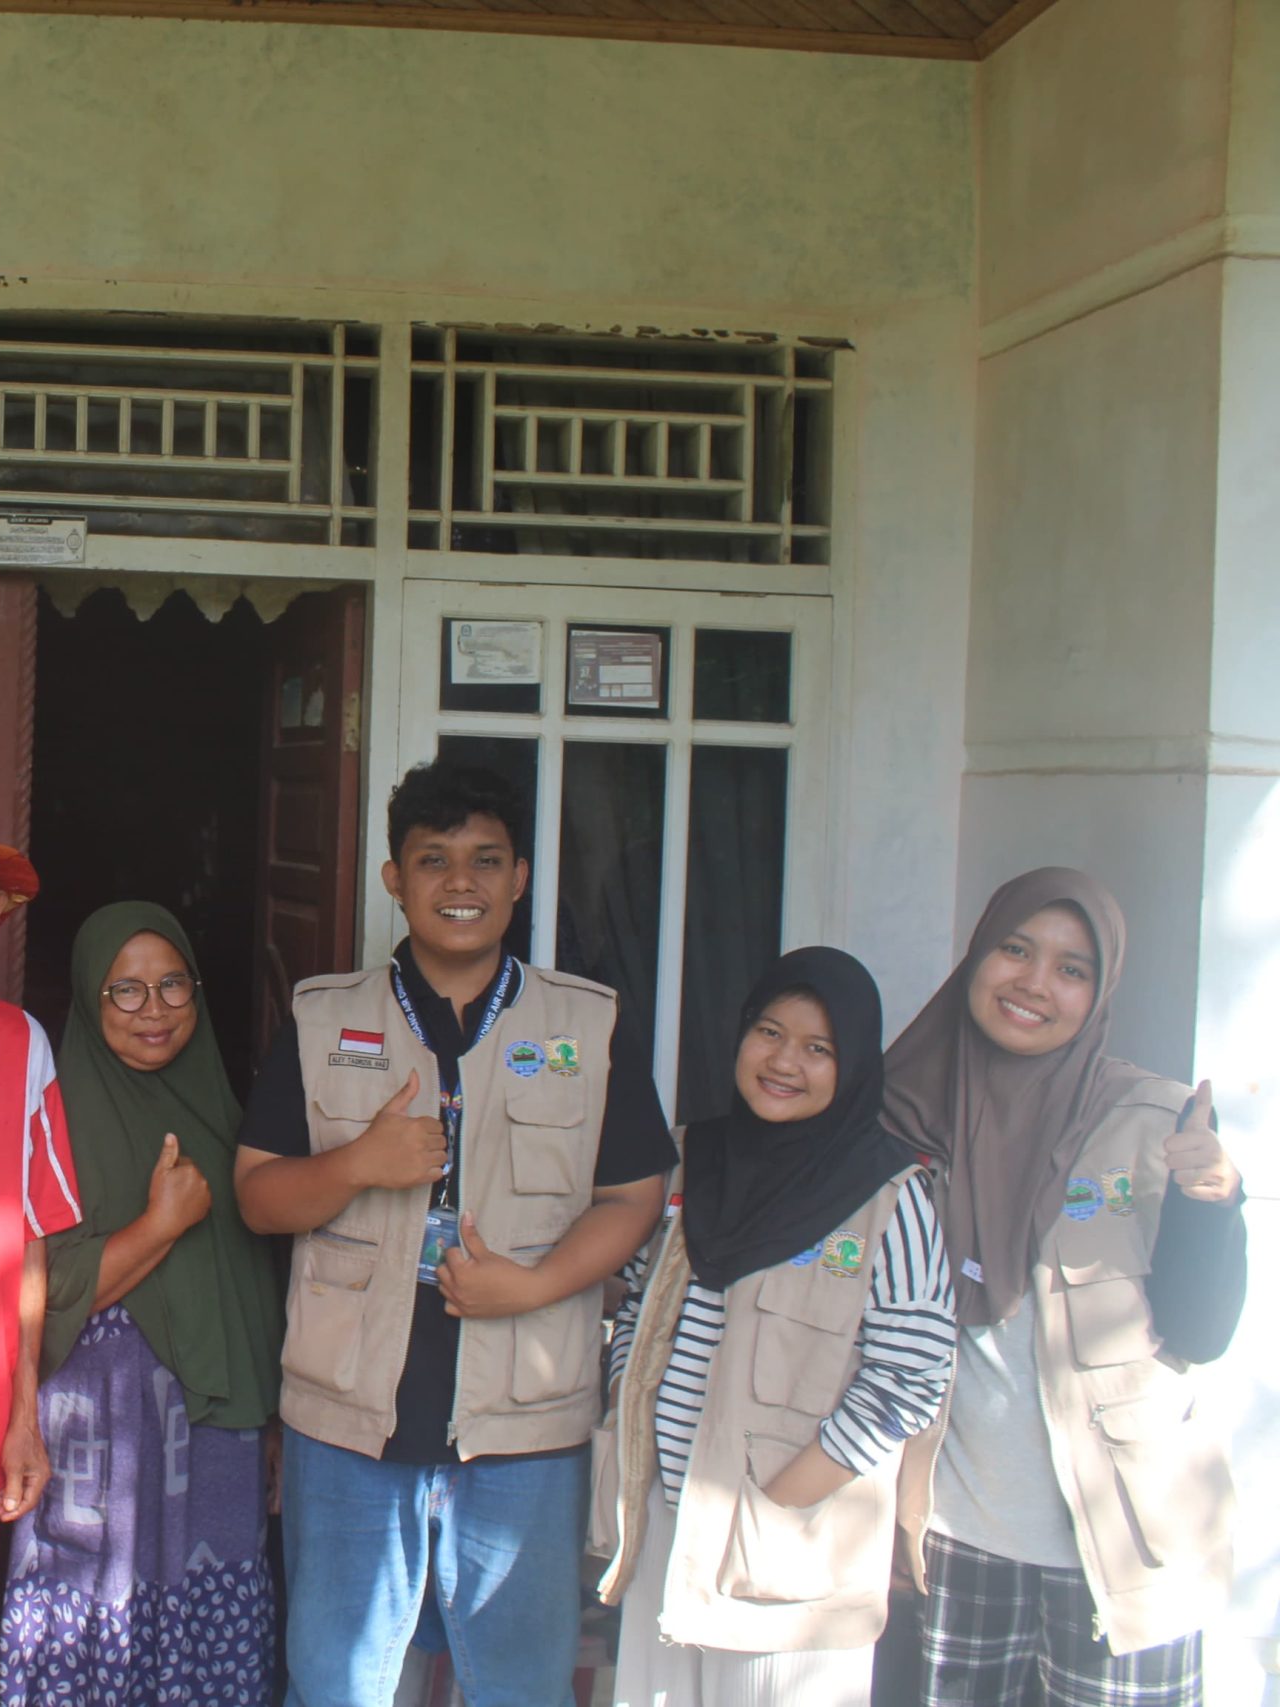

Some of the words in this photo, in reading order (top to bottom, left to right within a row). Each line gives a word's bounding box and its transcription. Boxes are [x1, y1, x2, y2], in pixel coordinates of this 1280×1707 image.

[400, 999, 412, 1013] AIR
[478, 1010, 497, 1040] ADANG
[490, 996, 504, 1015] AIR
